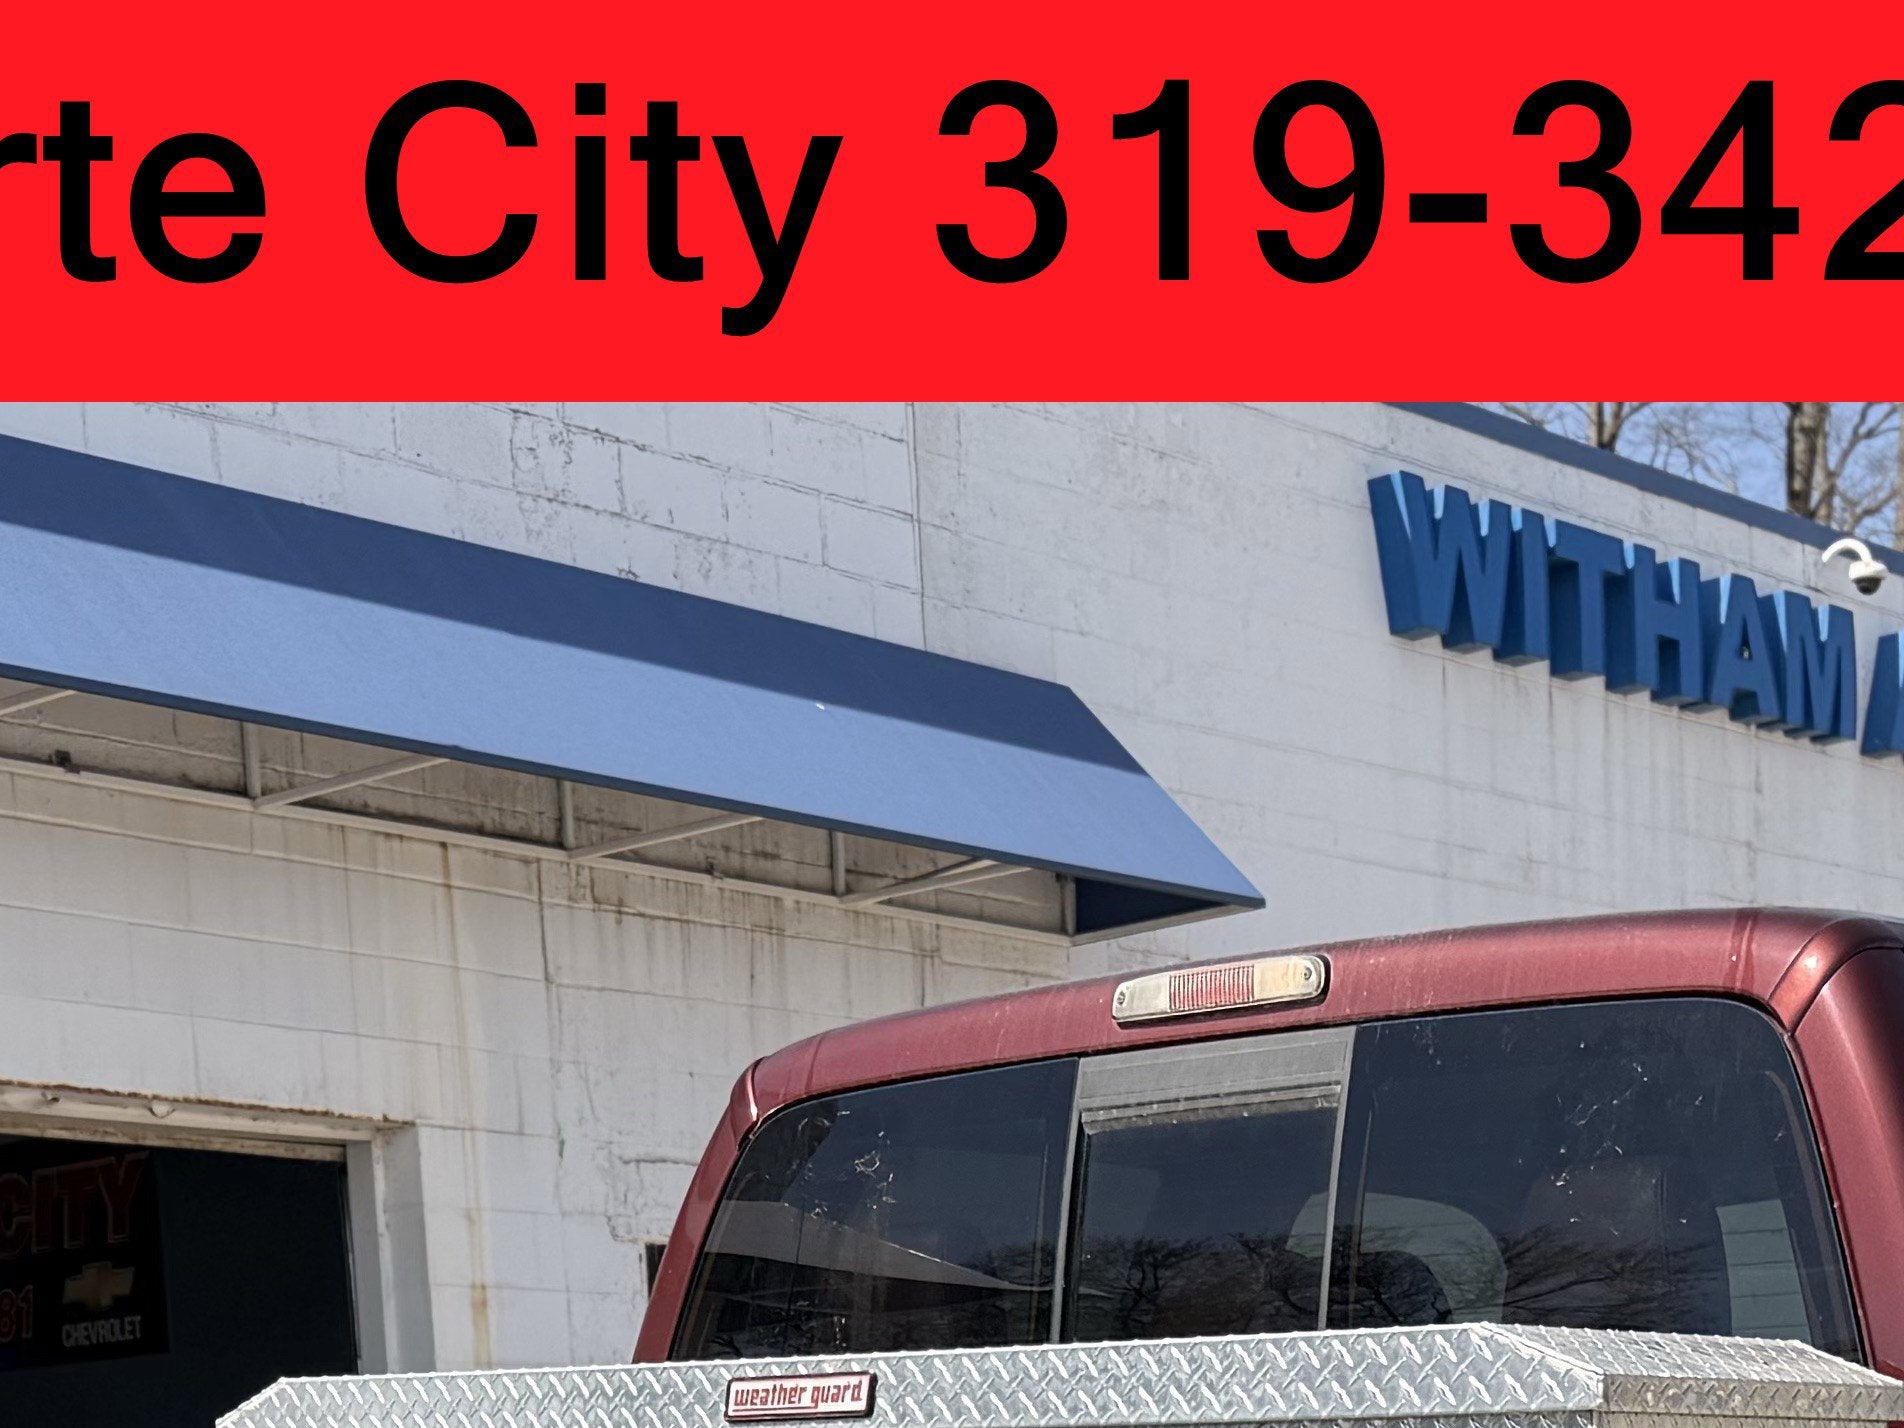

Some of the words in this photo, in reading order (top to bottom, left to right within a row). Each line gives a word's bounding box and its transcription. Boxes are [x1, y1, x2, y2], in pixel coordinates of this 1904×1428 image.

[1367, 469, 1857, 744] WITHAM
[61, 1314, 142, 1347] CHEVROLET
[733, 1383, 807, 1407] weather
[810, 1379, 863, 1409] guard
